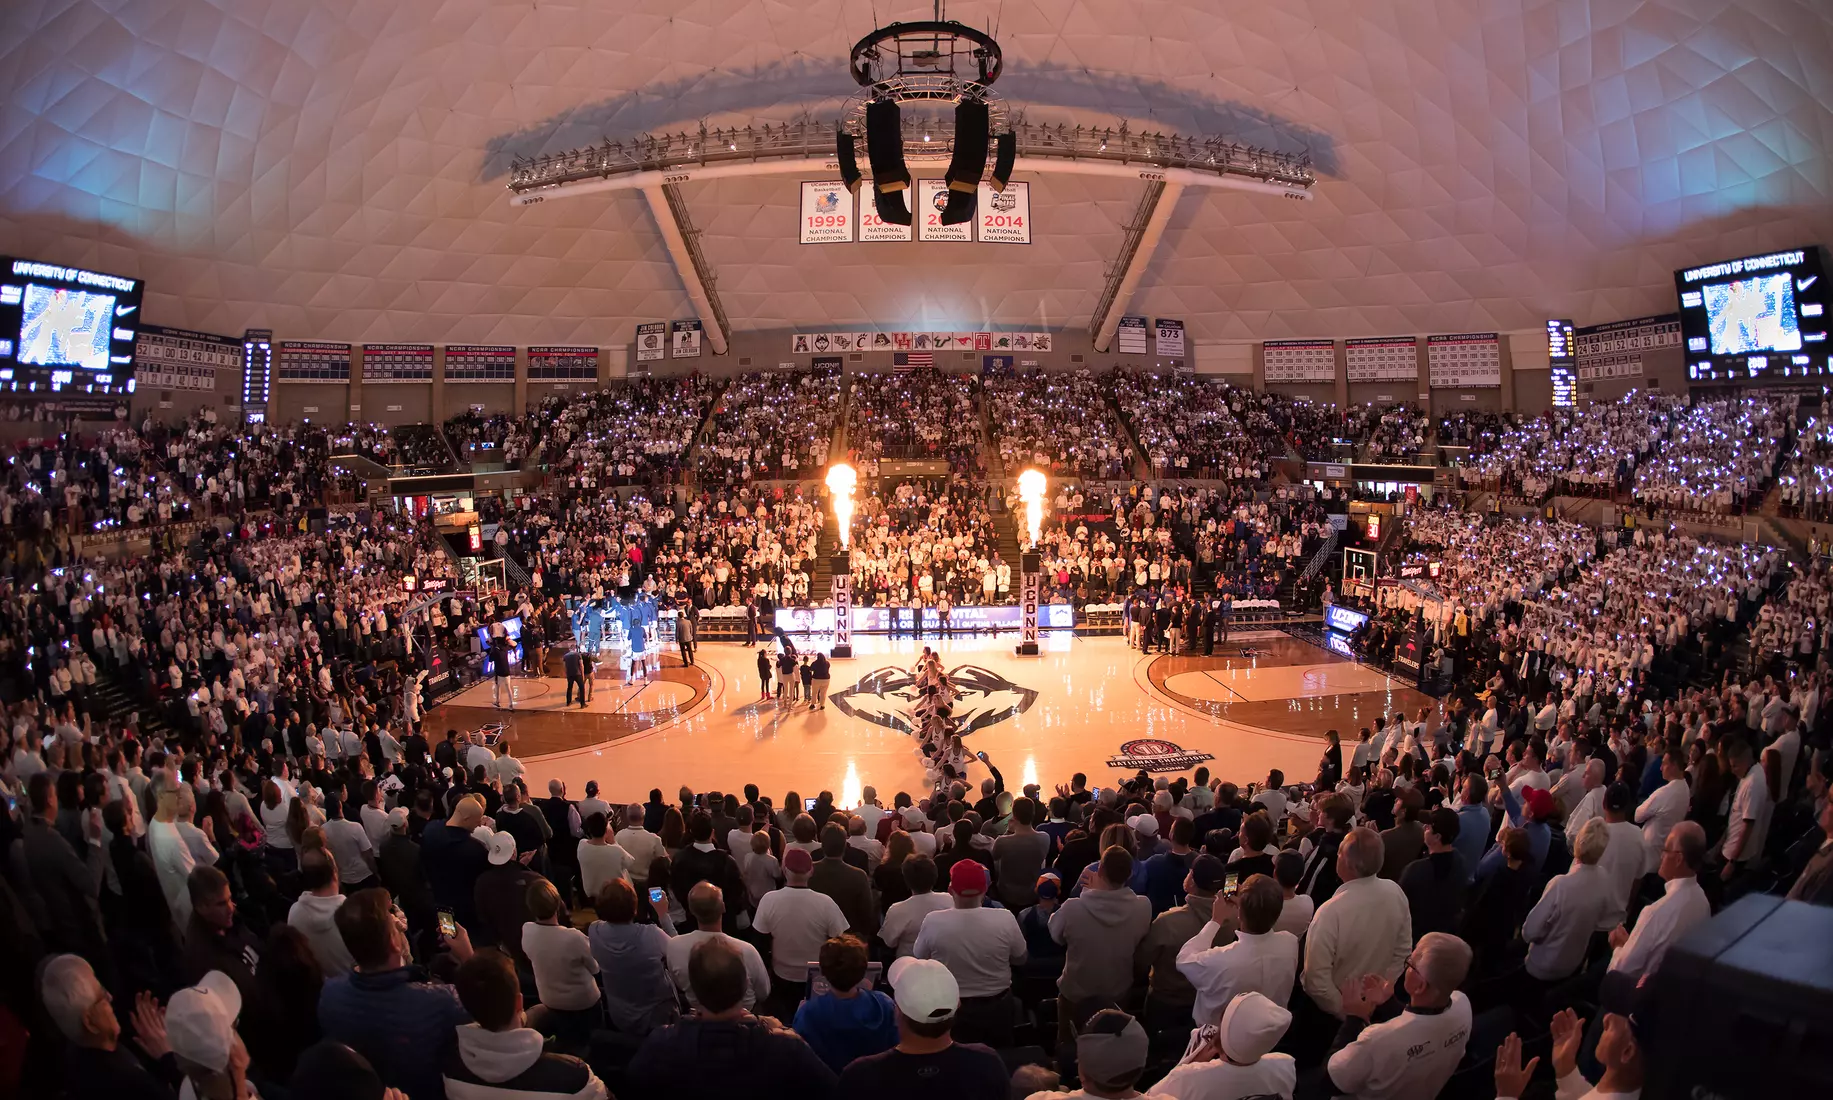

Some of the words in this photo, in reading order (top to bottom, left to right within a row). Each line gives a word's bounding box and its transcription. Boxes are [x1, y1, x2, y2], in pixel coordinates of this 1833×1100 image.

[807, 215, 846, 228] 1999
[984, 215, 1024, 228] 2014
[1684, 262, 1732, 282] UNIVERSITY
[1731, 260, 1743, 273] OF
[1743, 251, 1805, 272] CONNECTICUT
[12, 260, 66, 281] UNIVERSITY
[65, 269, 79, 281] OF
[77, 270, 136, 292] CONNECTICUT
[1160, 329, 1179, 339] 873
[137, 344, 148, 355] 52
[179, 350, 188, 360] 13
[192, 351, 202, 361] 42
[1578, 345, 1588, 355] 24
[1591, 343, 1600, 353] 50
[1604, 341, 1612, 351] 21
[1616, 340, 1625, 350] 52
[1629, 338, 1639, 348] 42
[1368, 525, 1379, 539] 30
[471, 535, 480, 549] 30
[836, 578, 847, 643] UCONN
[951, 608, 988, 620] VITAL
[1025, 576, 1036, 641] UCONN
[1331, 607, 1365, 626] UCONN
[1398, 655, 1420, 670] TRAVELERS
[1109, 758, 1156, 767] NATIONAL
[1158, 754, 1212, 764] CHAMPIONS
